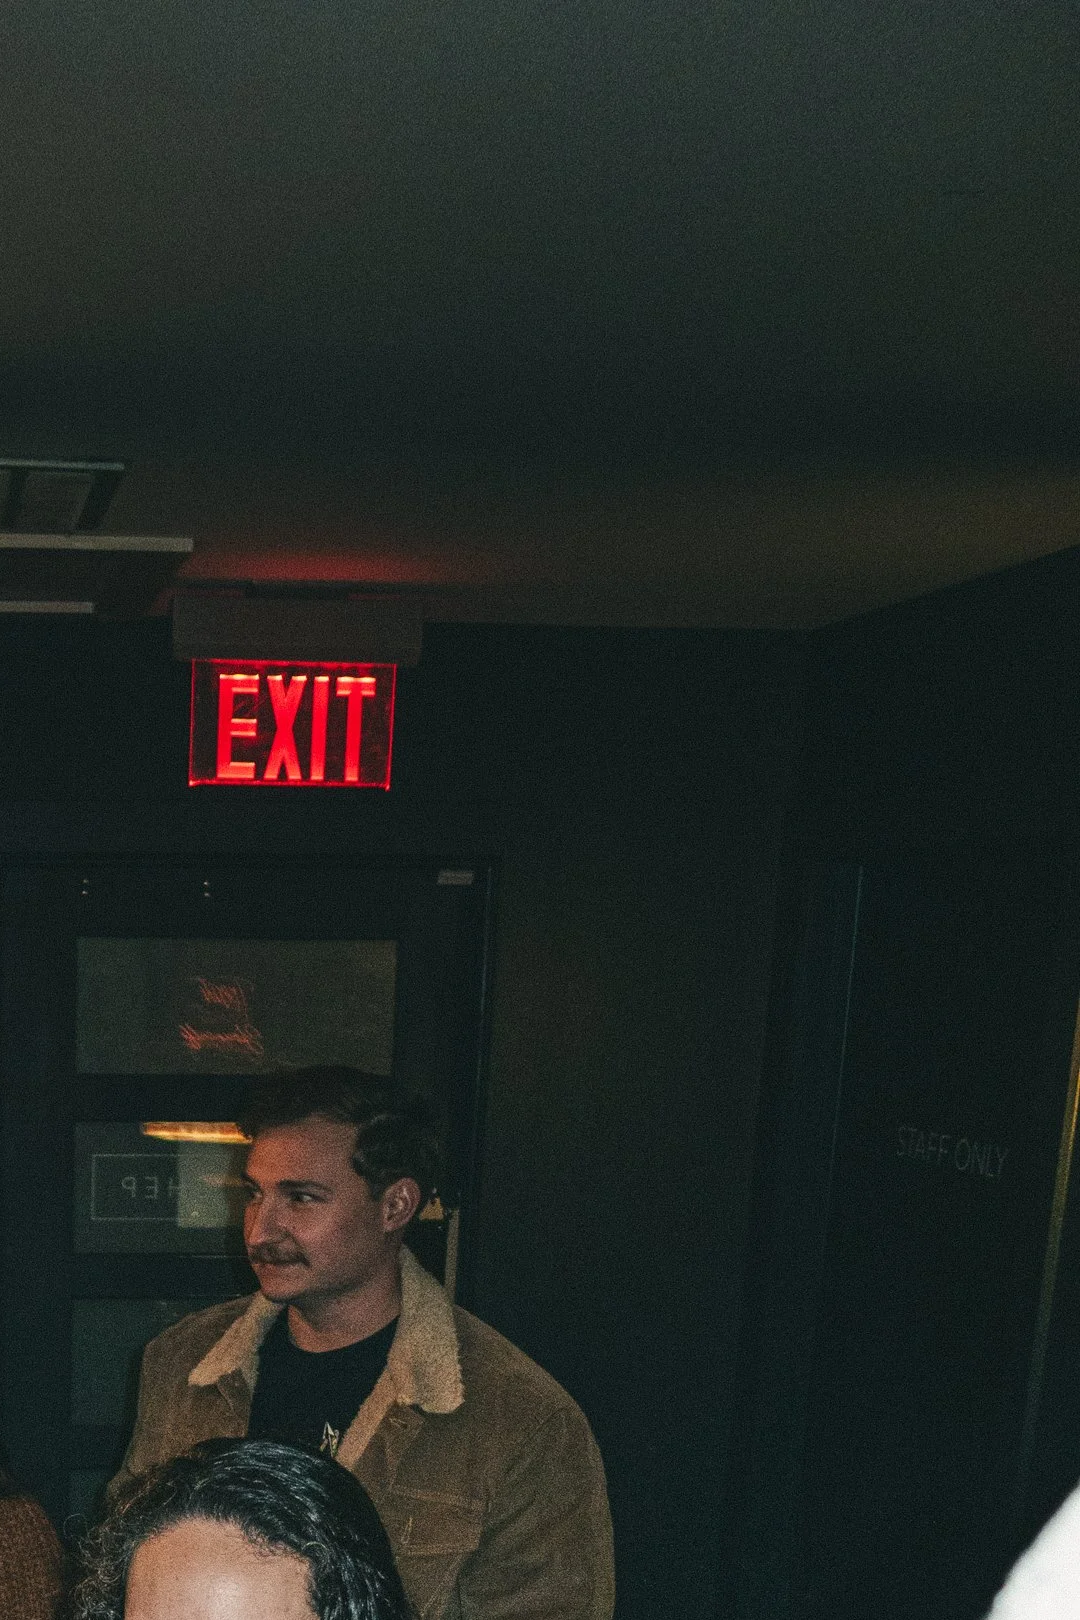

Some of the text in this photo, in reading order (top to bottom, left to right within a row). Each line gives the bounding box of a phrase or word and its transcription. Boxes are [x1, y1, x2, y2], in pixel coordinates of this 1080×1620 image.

[216, 673, 376, 782] EXIT
[896, 1124, 1011, 1179] STAFF ONLY
